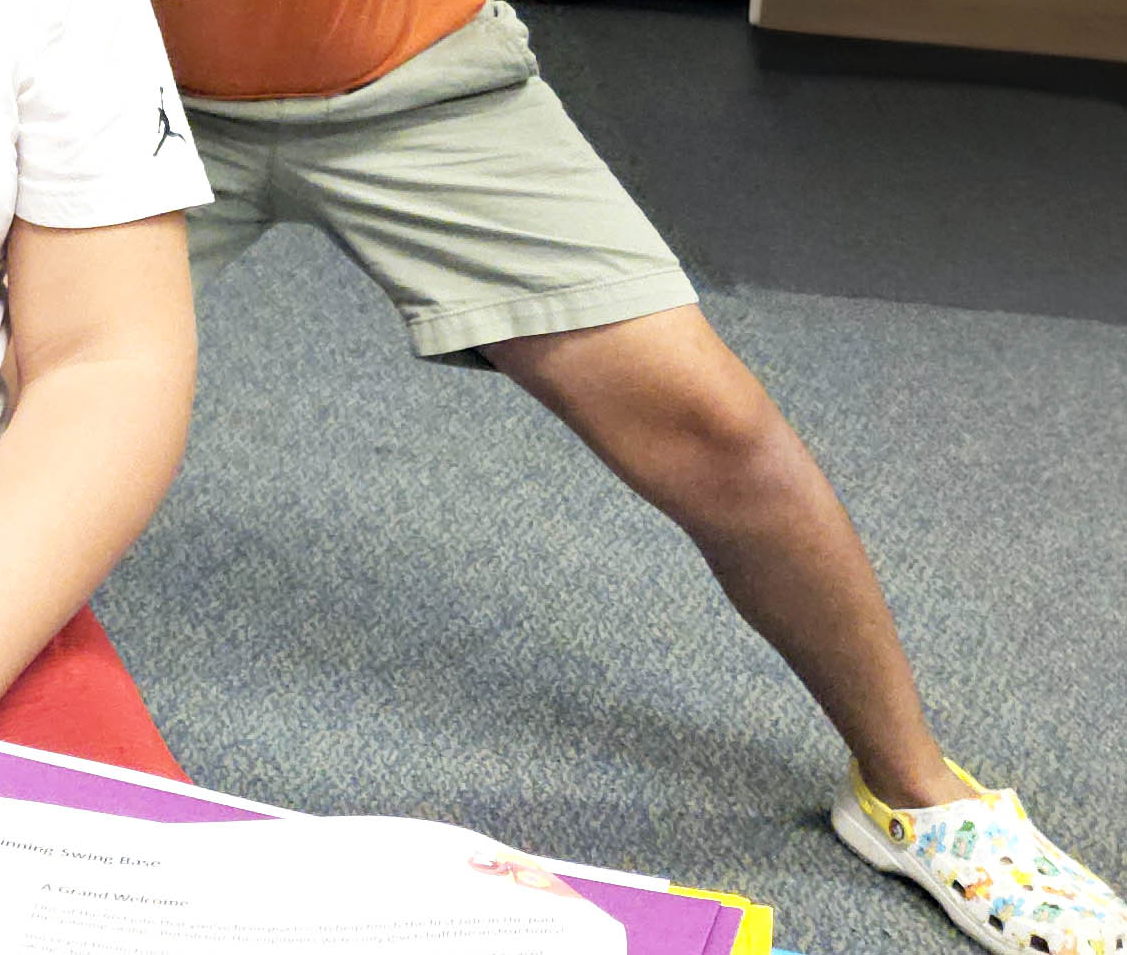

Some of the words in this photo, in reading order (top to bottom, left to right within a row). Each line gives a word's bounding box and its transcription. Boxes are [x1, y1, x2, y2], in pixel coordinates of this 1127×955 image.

[61, 848, 114, 866] Swing
[119, 856, 162, 867] Base
[40, 883, 52, 892] A
[58, 886, 109, 900] Grand
[113, 892, 190, 907] Welcome
